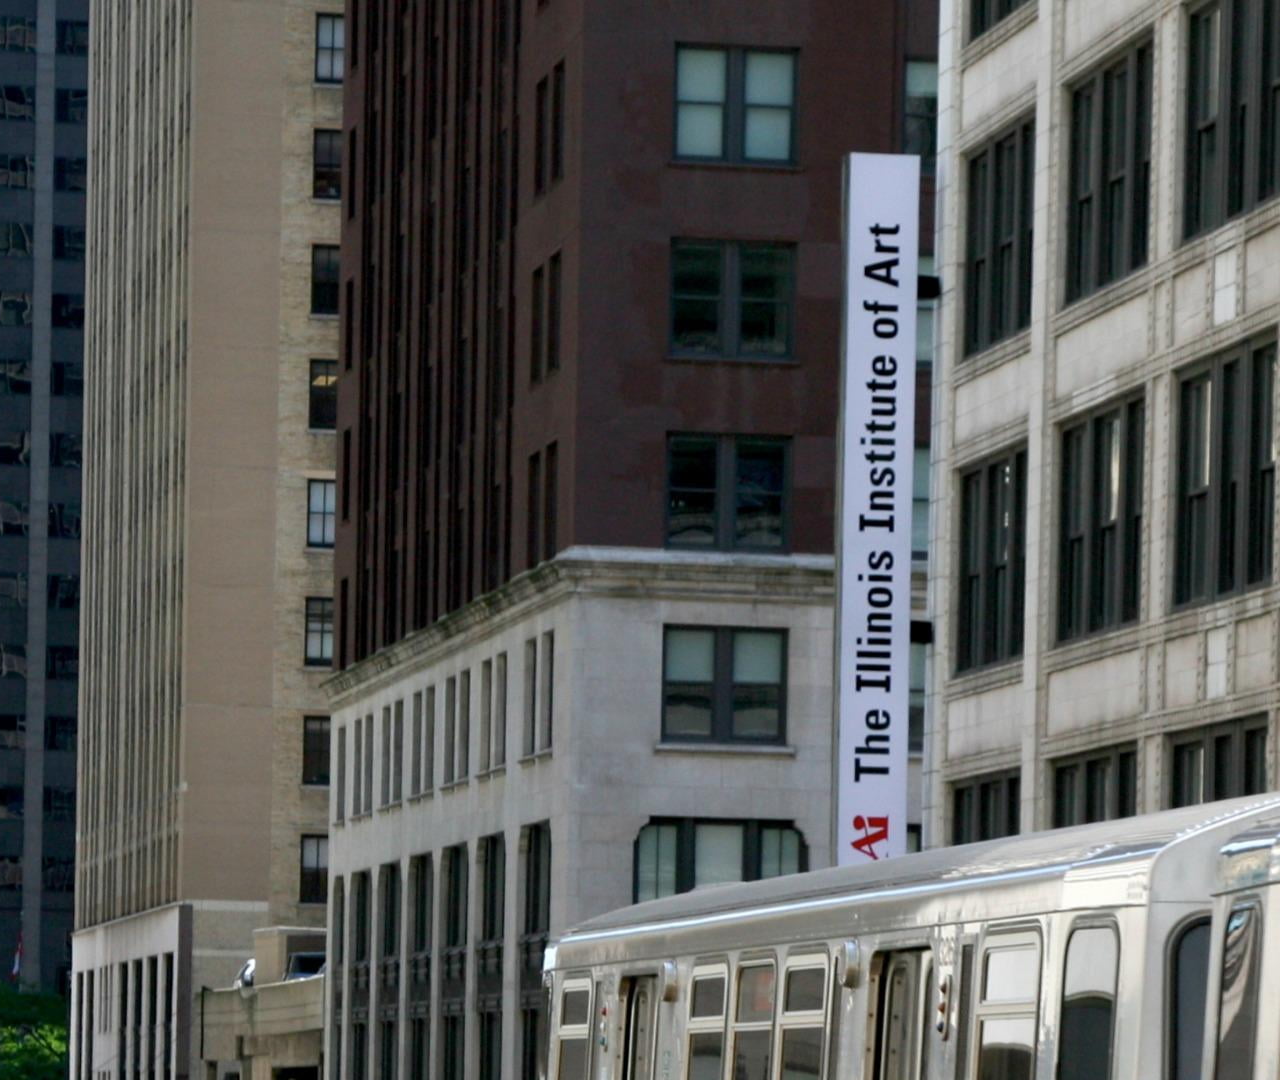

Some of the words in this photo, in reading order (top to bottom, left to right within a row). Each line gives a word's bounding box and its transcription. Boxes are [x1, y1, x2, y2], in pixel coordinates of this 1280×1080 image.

[864, 223, 900, 287] Art
[864, 301, 899, 339] of
[859, 355, 898, 532] Institute
[856, 551, 894, 692] Illinois
[854, 709, 891, 782] The
